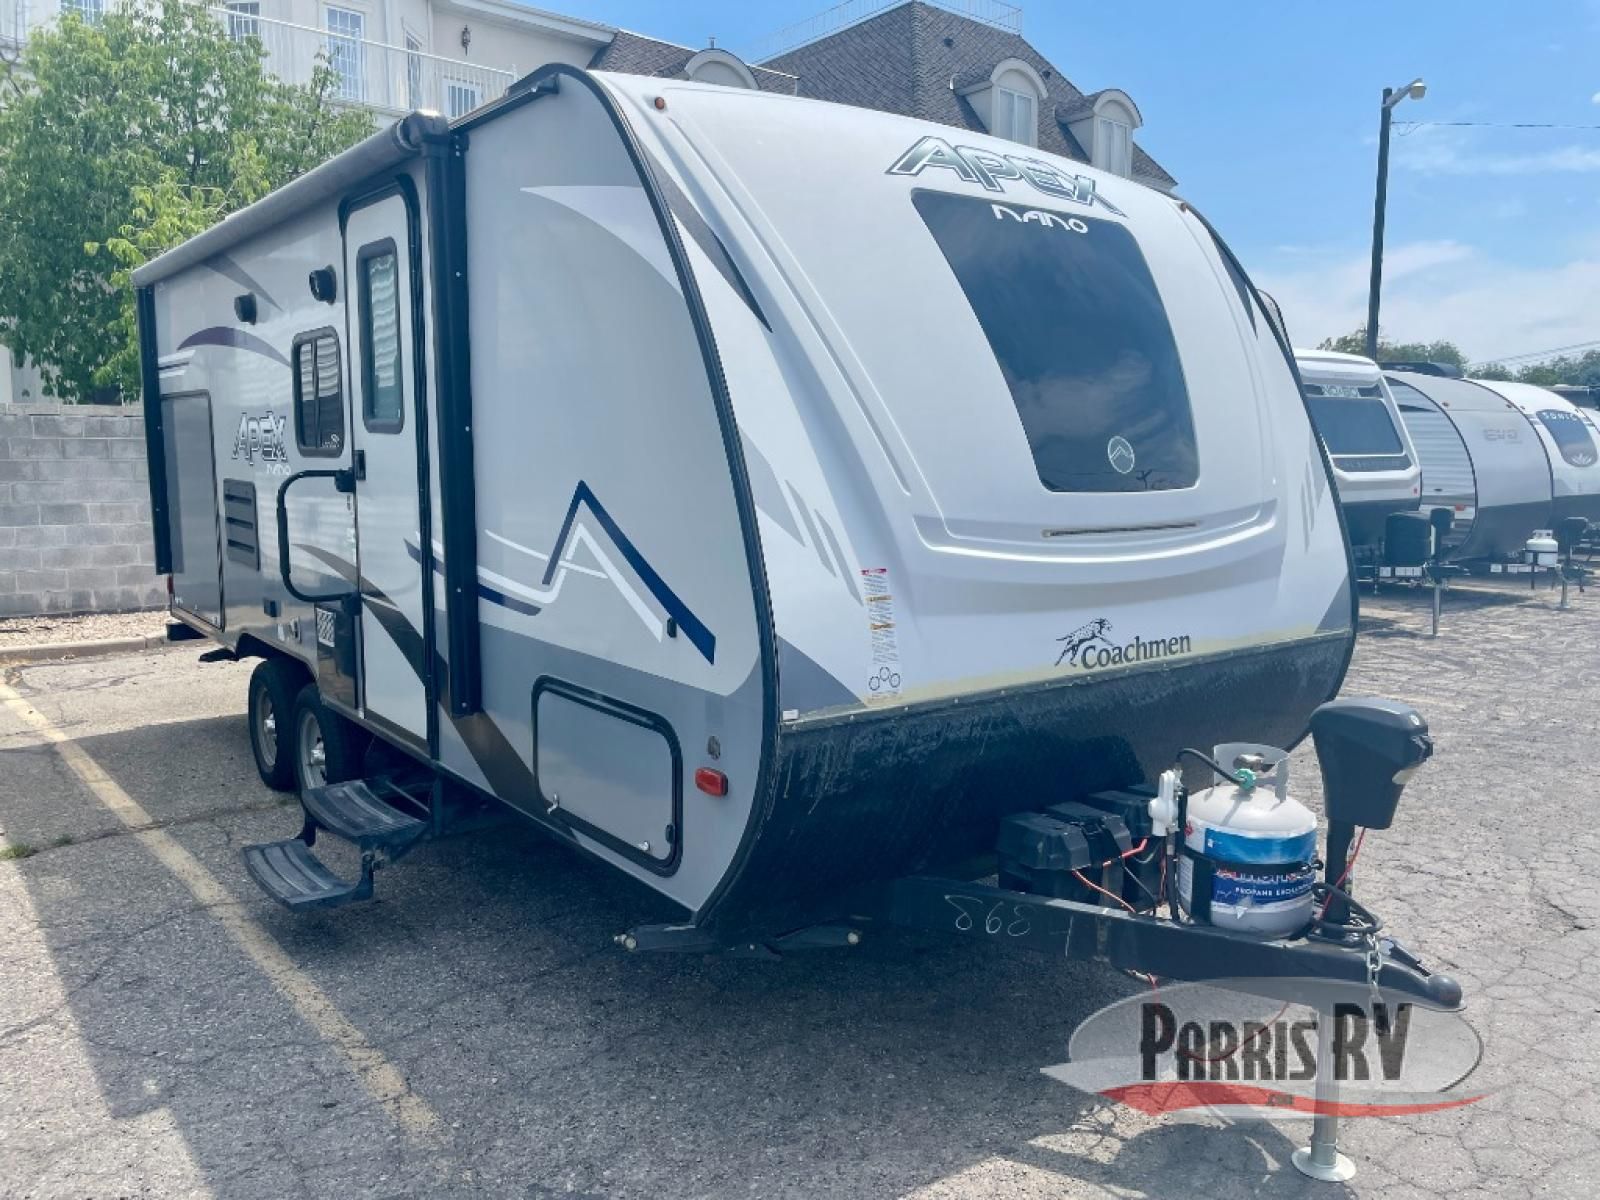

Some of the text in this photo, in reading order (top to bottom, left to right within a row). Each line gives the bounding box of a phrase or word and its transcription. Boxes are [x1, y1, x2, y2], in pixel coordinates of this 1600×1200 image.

[885, 136, 1127, 217] APEX
[231, 410, 288, 466] APEX
[1081, 635, 1192, 669] Coachmen
